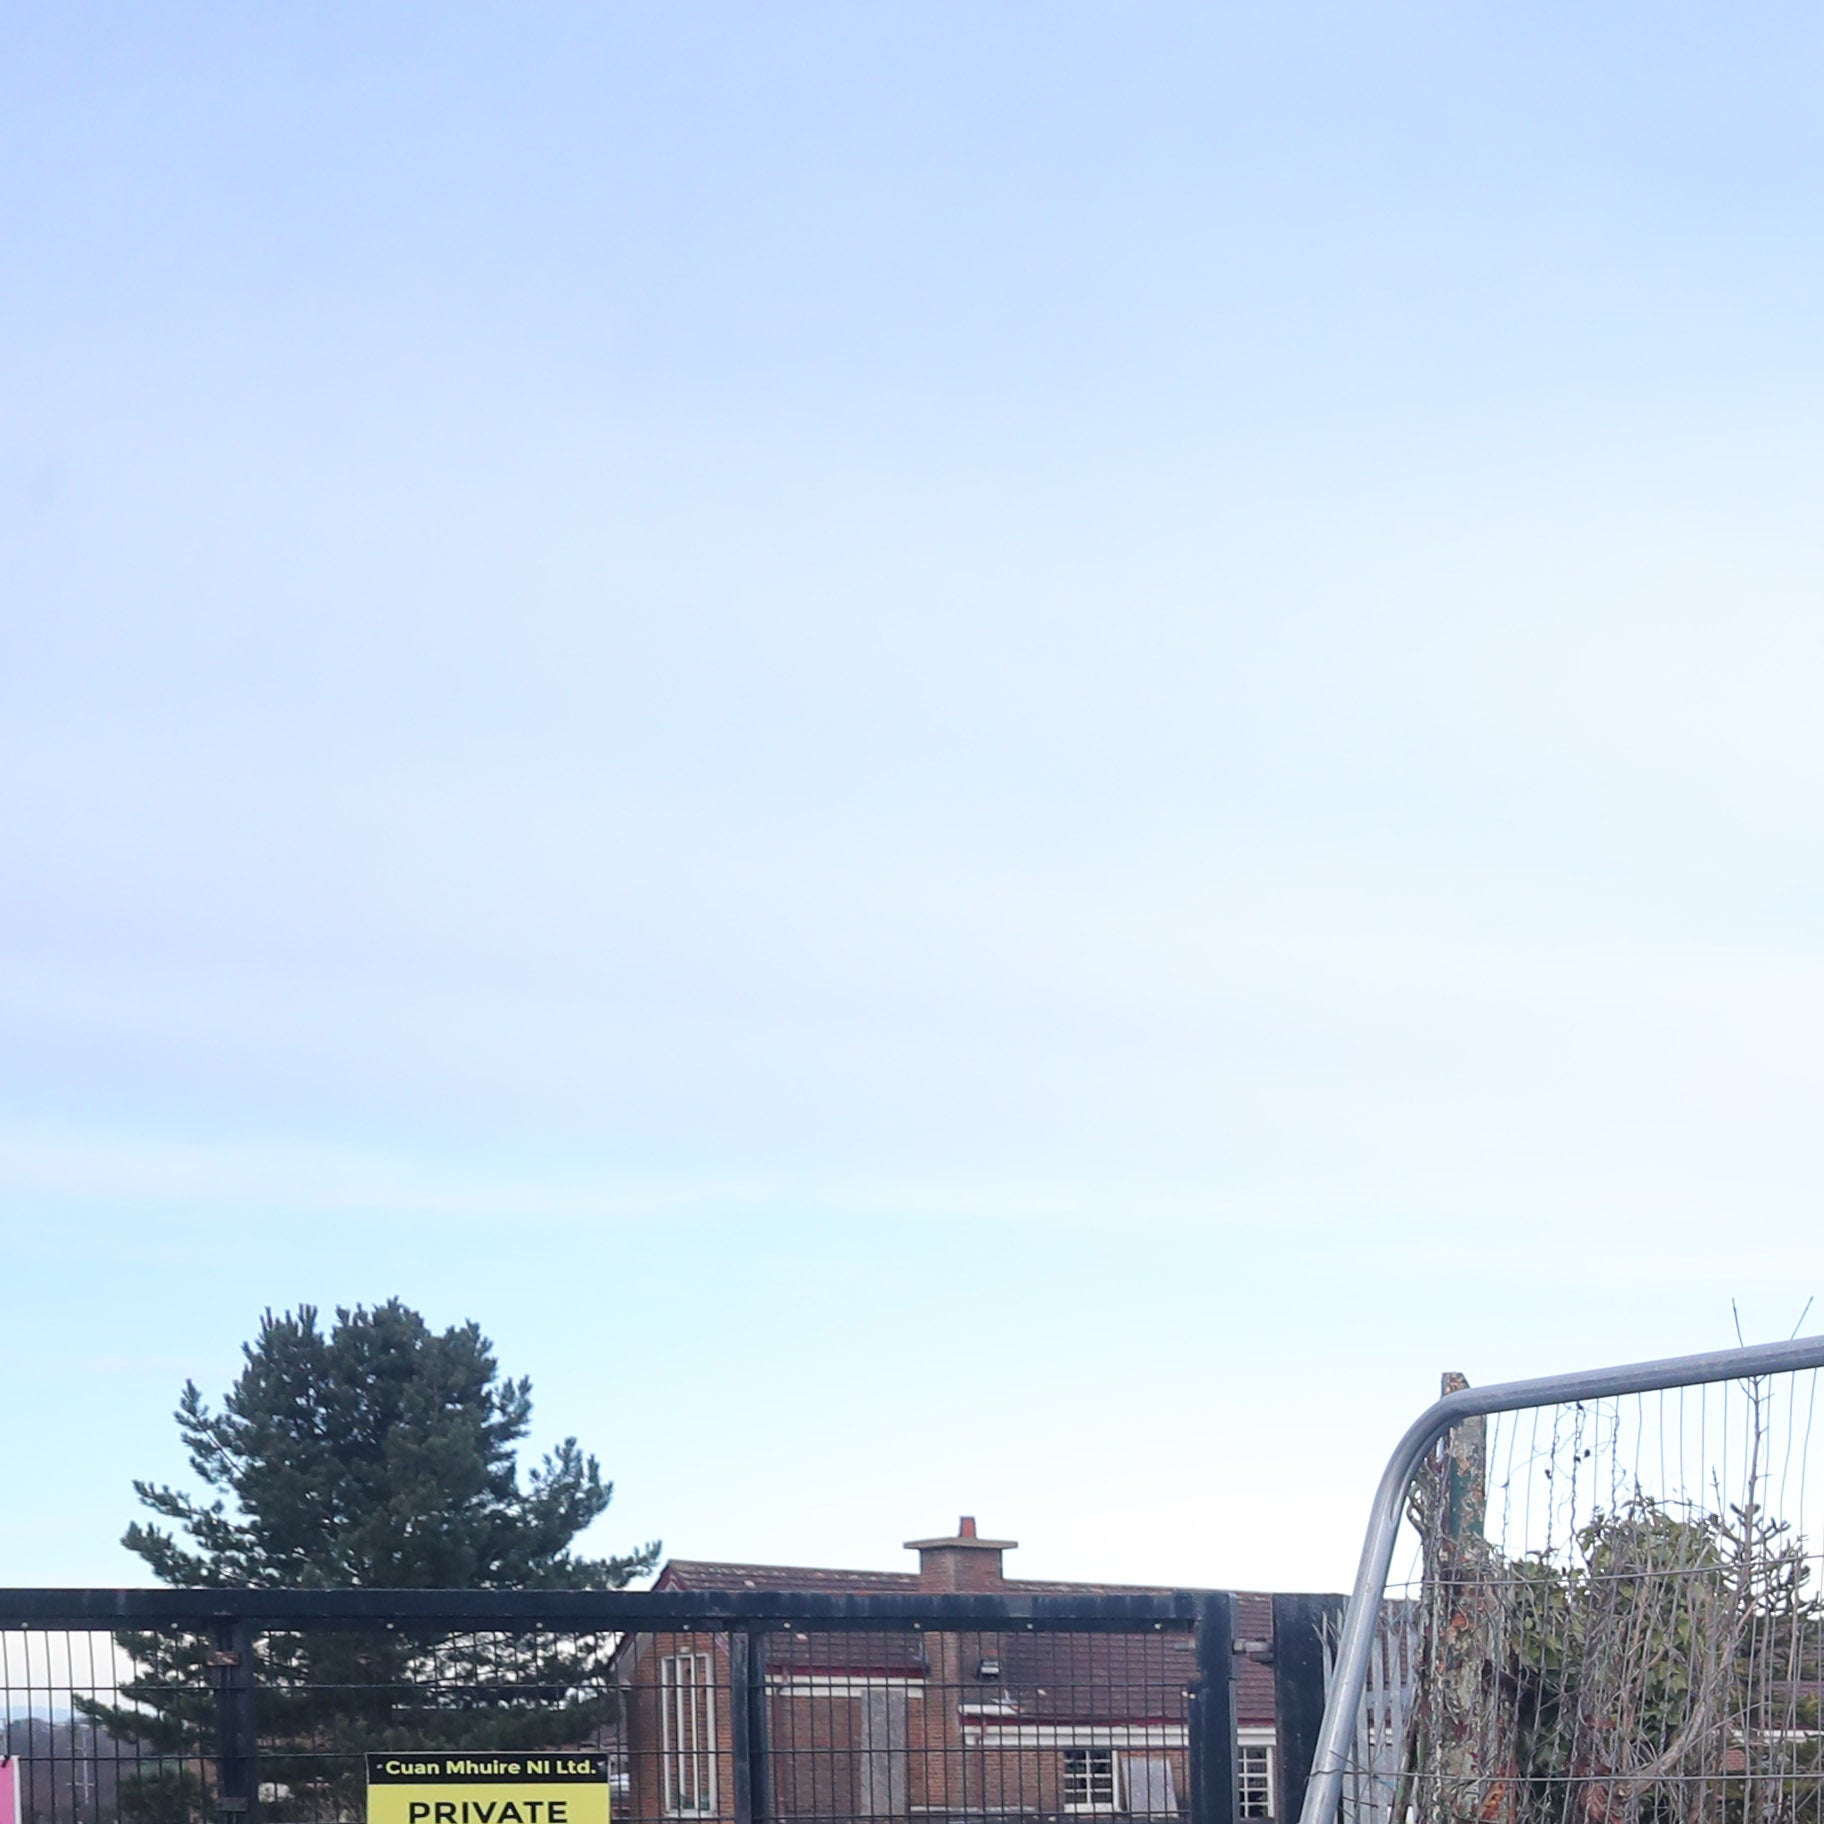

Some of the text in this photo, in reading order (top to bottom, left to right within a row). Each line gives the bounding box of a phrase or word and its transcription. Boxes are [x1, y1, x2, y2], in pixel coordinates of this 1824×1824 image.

[385, 1759, 597, 1775] Cuan Mhuire NI Ltd.
[409, 1801, 569, 1824] PRIVATE
